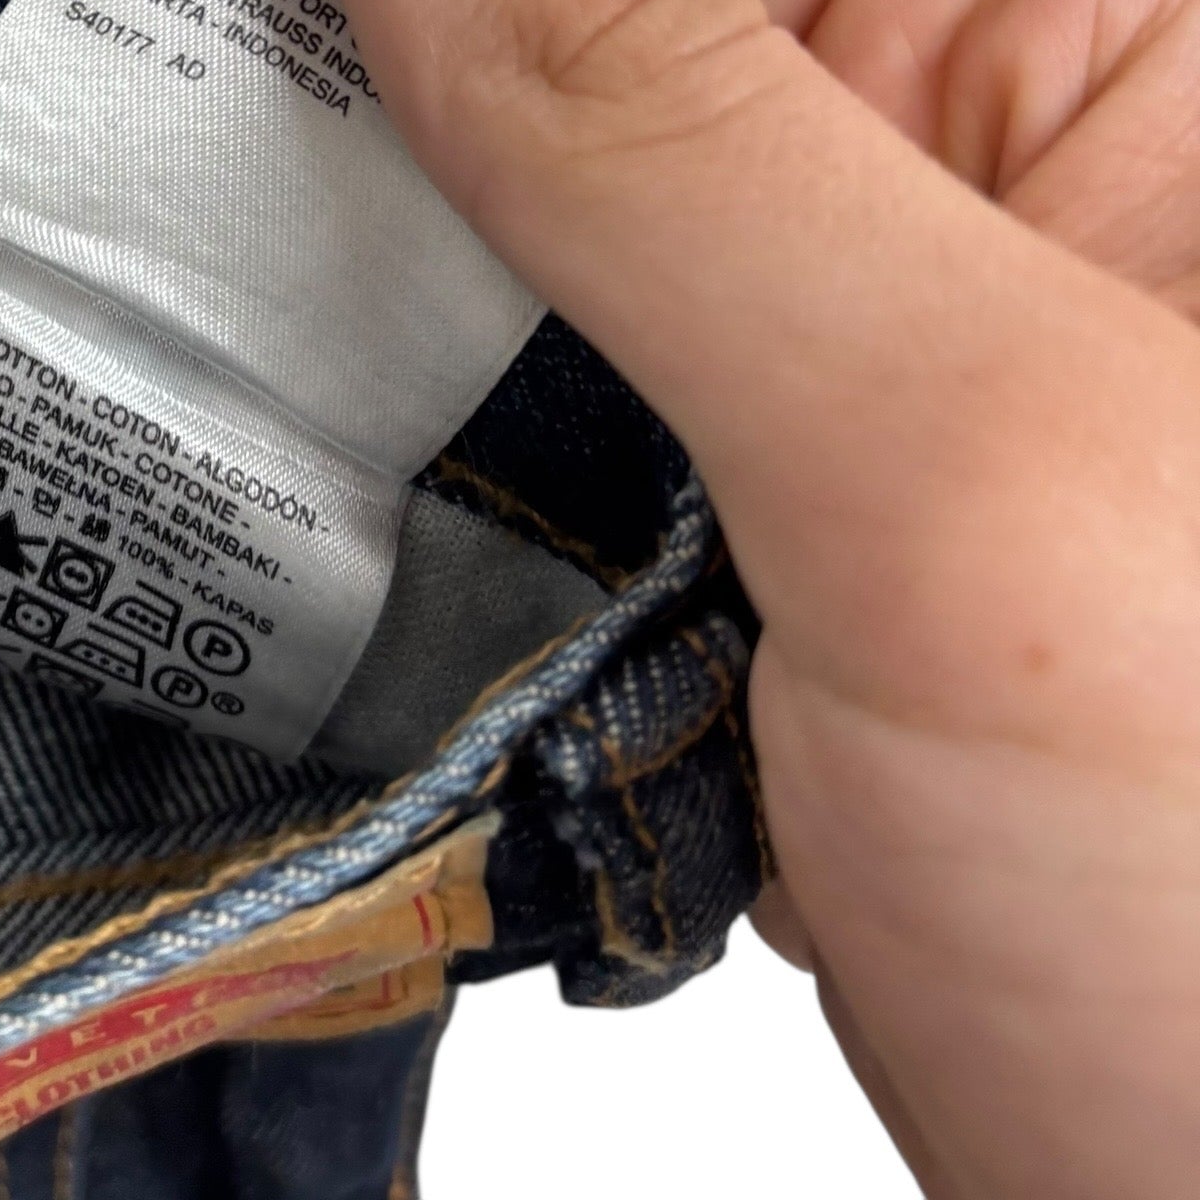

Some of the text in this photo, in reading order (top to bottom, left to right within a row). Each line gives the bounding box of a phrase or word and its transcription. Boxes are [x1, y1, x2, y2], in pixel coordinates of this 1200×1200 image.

[64, 0, 206, 82] S40177 AD
[222, 20, 352, 118] INDONESIA
[30, 394, 119, 458] PAMUK
[134, 452, 240, 525] COTONE
[91, 395, 181, 457] COTON
[193, 451, 317, 532] ALGODÓN
[55, 440, 156, 507] KATOEN
[169, 504, 281, 581] BAMBAKI
[129, 508, 216, 569] PAMUT
[118, 535, 176, 580] 100%
[191, 579, 275, 636] KAPAS
